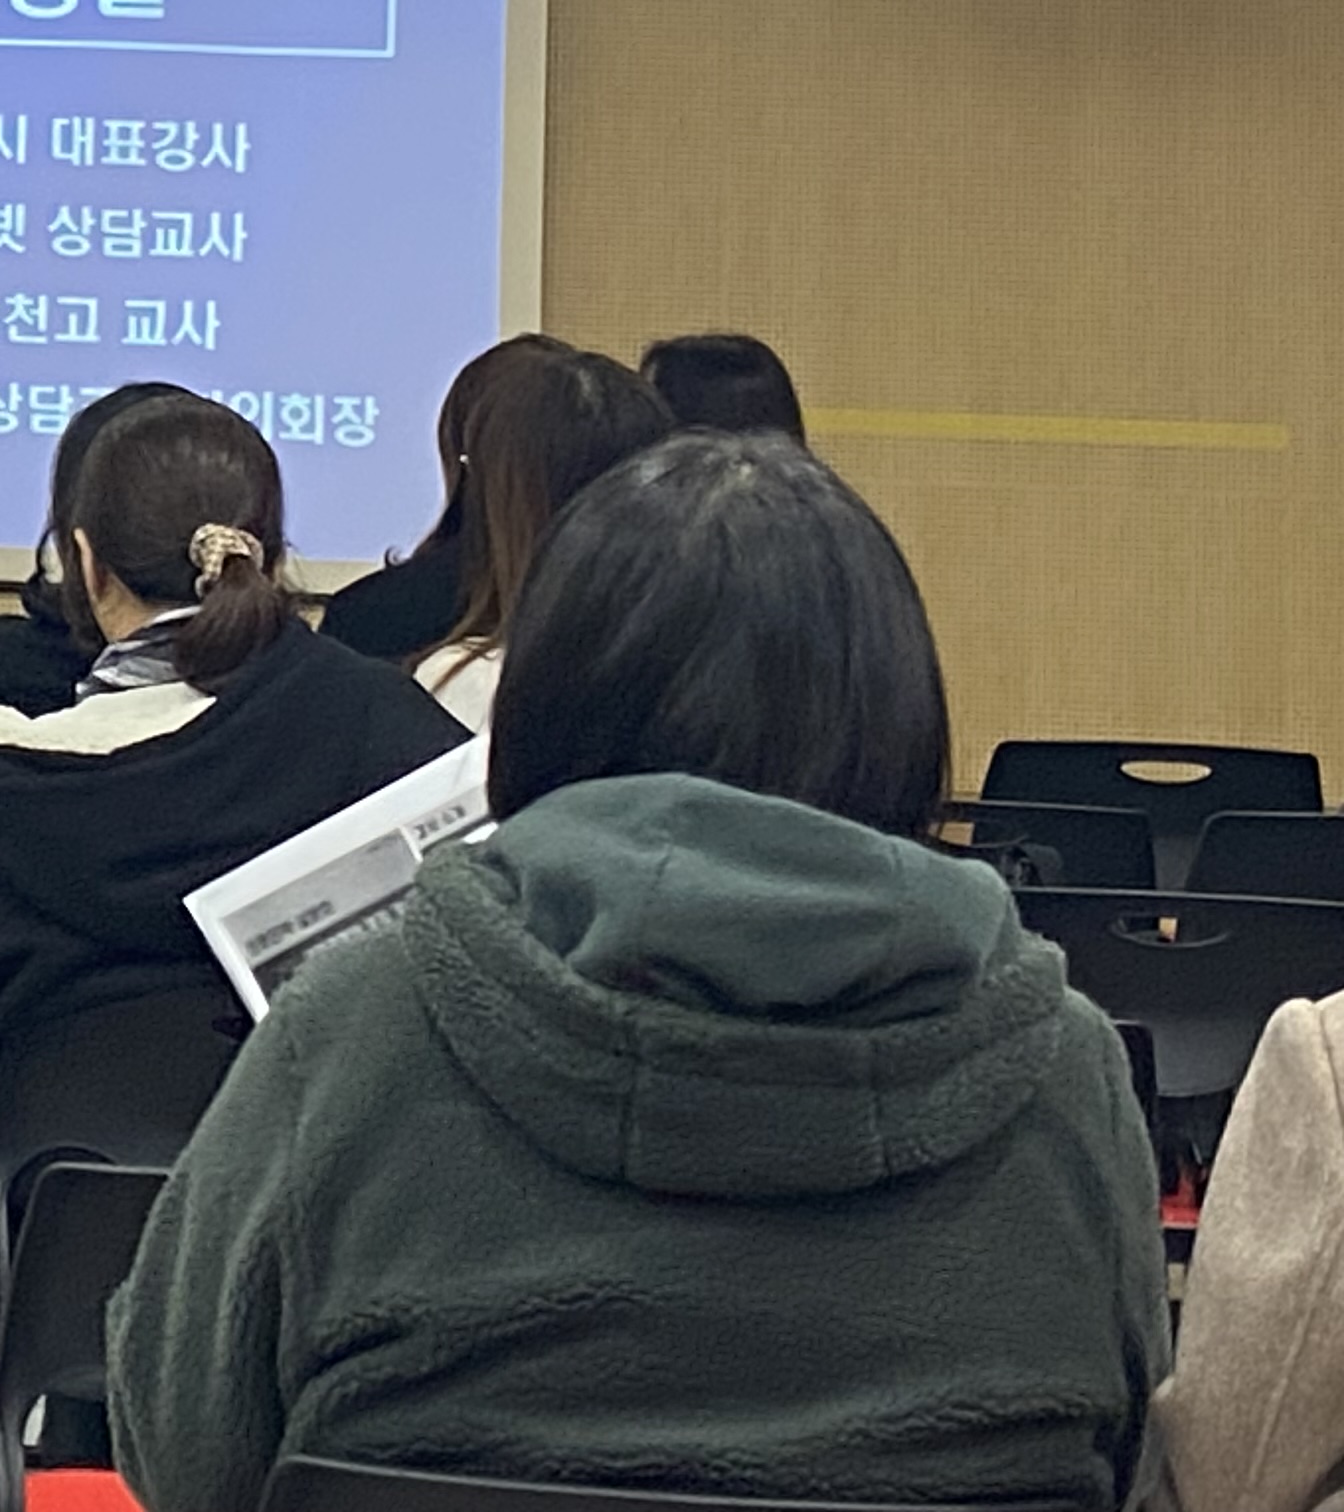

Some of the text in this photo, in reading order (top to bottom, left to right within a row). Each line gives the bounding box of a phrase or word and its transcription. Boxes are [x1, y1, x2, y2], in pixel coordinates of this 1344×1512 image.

[50, 116, 251, 174] 대표강사
[47, 205, 249, 263] 상담교사
[120, 298, 221, 351] 교사
